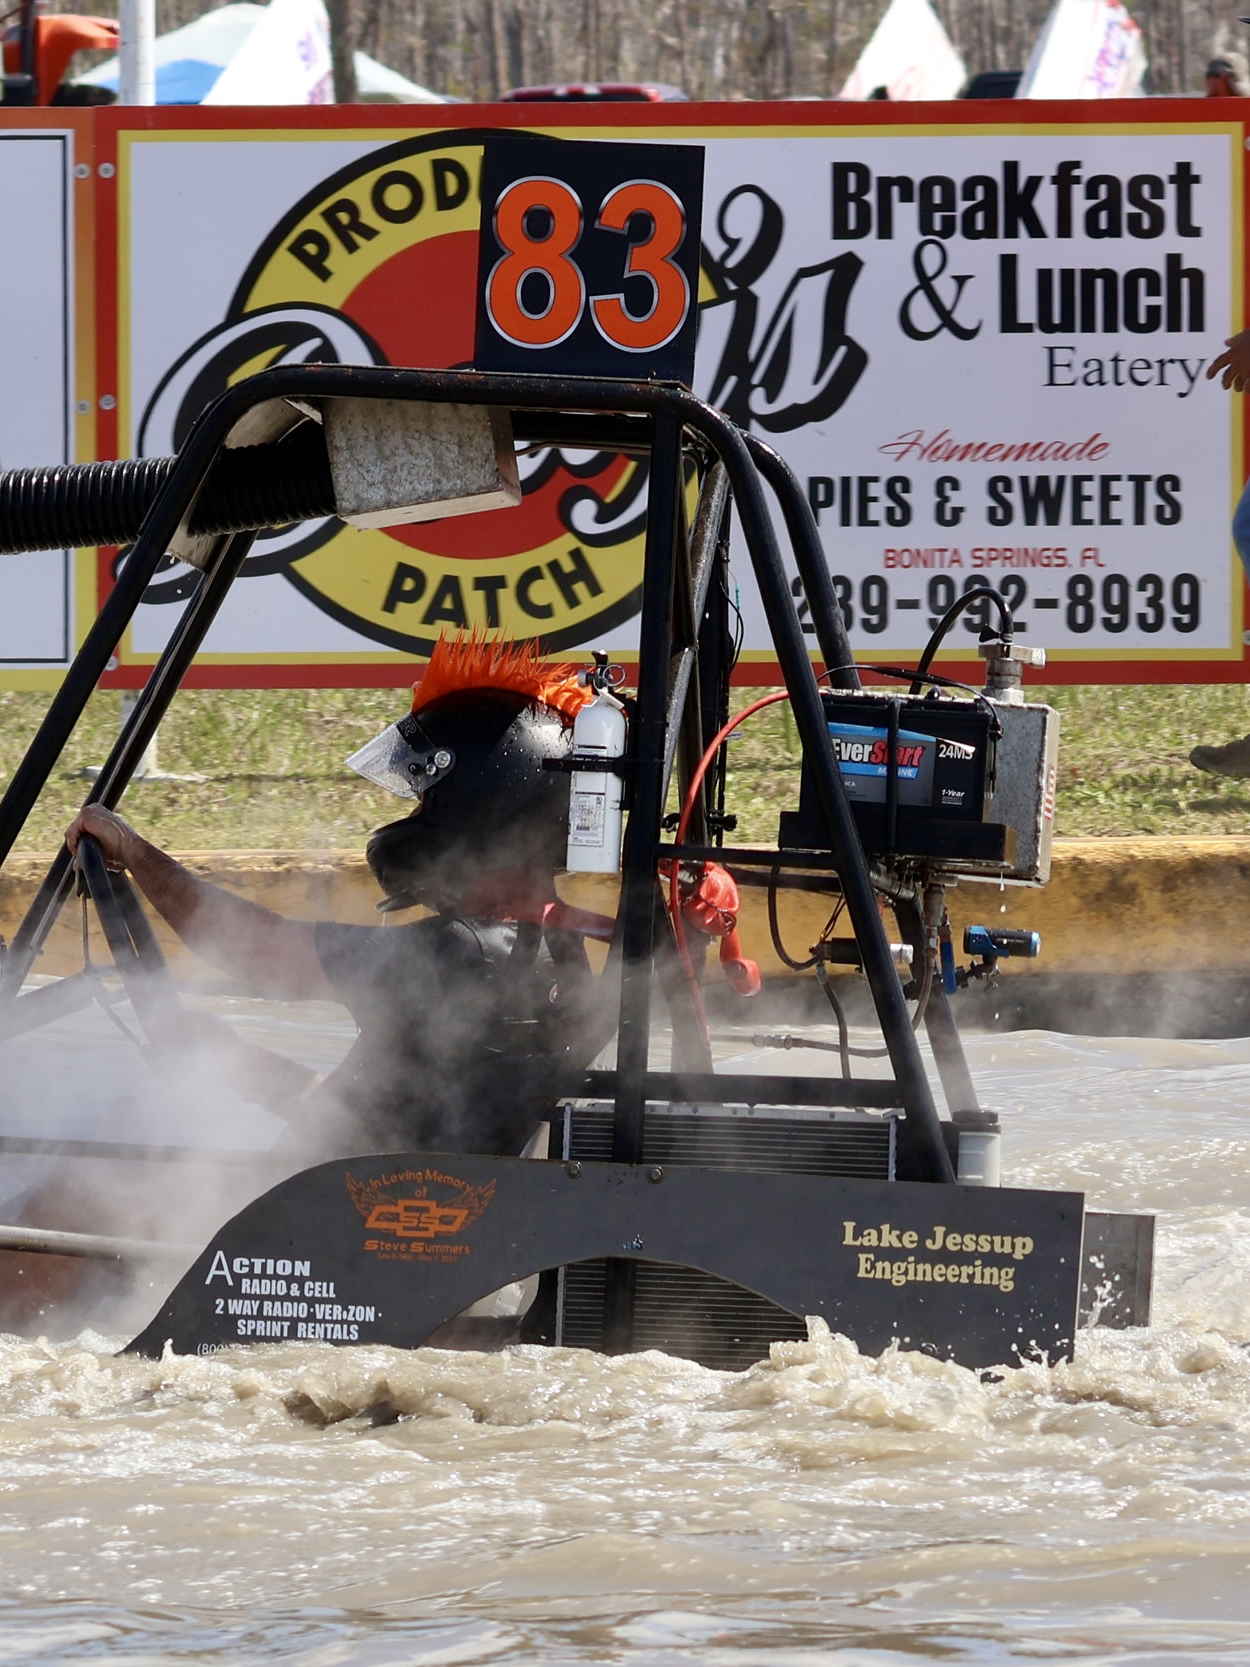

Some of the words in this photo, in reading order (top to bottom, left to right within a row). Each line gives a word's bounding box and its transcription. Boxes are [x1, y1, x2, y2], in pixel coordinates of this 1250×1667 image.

[832, 160, 1202, 240] Breakfast
[287, 156, 485, 282] PROD
[485, 175, 691, 353] 83
[898, 236, 983, 341] &
[1000, 253, 1205, 334] Lunch
[1042, 346, 1208, 397] Eatery
[877, 429, 1112, 463] Homemade
[807, 475, 912, 528] PIES
[935, 475, 966, 527] &
[987, 474, 1182, 527] SWEETS
[883, 548, 963, 569] BONITA
[971, 547, 1072, 568] SPRINGS,
[381, 546, 603, 630] PATCH
[877, 766, 914, 777] MINE
[941, 789, 965, 798] 1-Year
[381, 1169, 423, 1186] Loving
[424, 1168, 474, 1196] Memory
[414, 1186, 428, 1198] of
[364, 1239, 407, 1251] Steve
[410, 1241, 470, 1255] Summers
[842, 1221, 919, 1248] Lake
[925, 1226, 1034, 1260] Jessup
[205, 1250, 311, 1286] ACTION
[857, 1253, 1015, 1292] Engineering
[241, 1278, 288, 1296] RADIO
[290, 1283, 300, 1297] &
[304, 1281, 336, 1298] CELL
[215, 1298, 225, 1315] 2
[228, 1299, 260, 1316] WAY
[263, 1301, 308, 1318] RADIO
[237, 1319, 290, 1337] SPRINT
[297, 1322, 359, 1341] RENTALS
